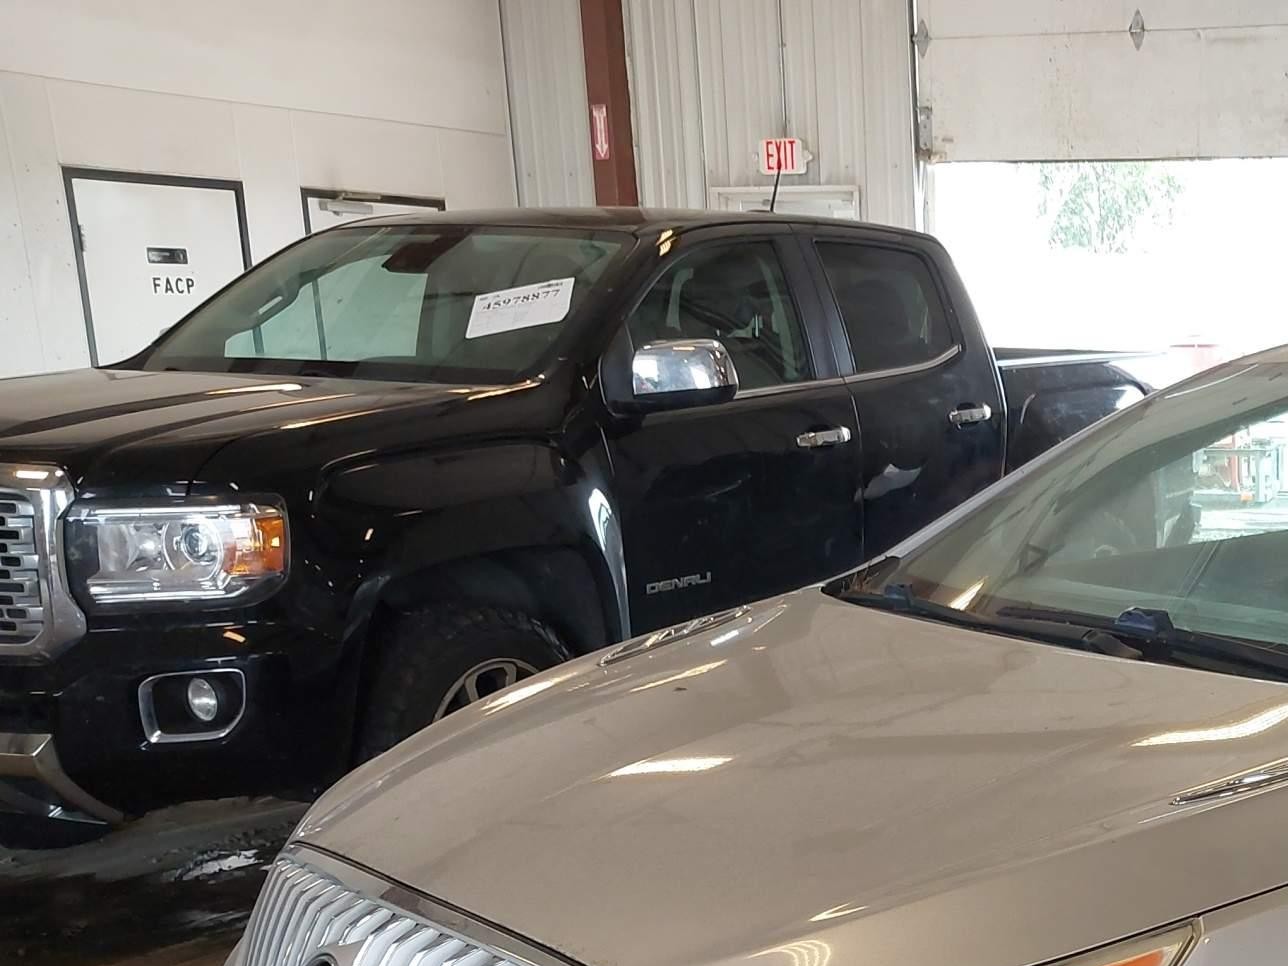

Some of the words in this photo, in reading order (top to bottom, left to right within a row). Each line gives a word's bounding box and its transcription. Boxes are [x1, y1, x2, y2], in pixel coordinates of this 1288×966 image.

[766, 140, 796, 170] EXIT
[152, 276, 195, 294] FACP
[482, 289, 561, 310] 45978877
[646, 571, 712, 595] DENALI
